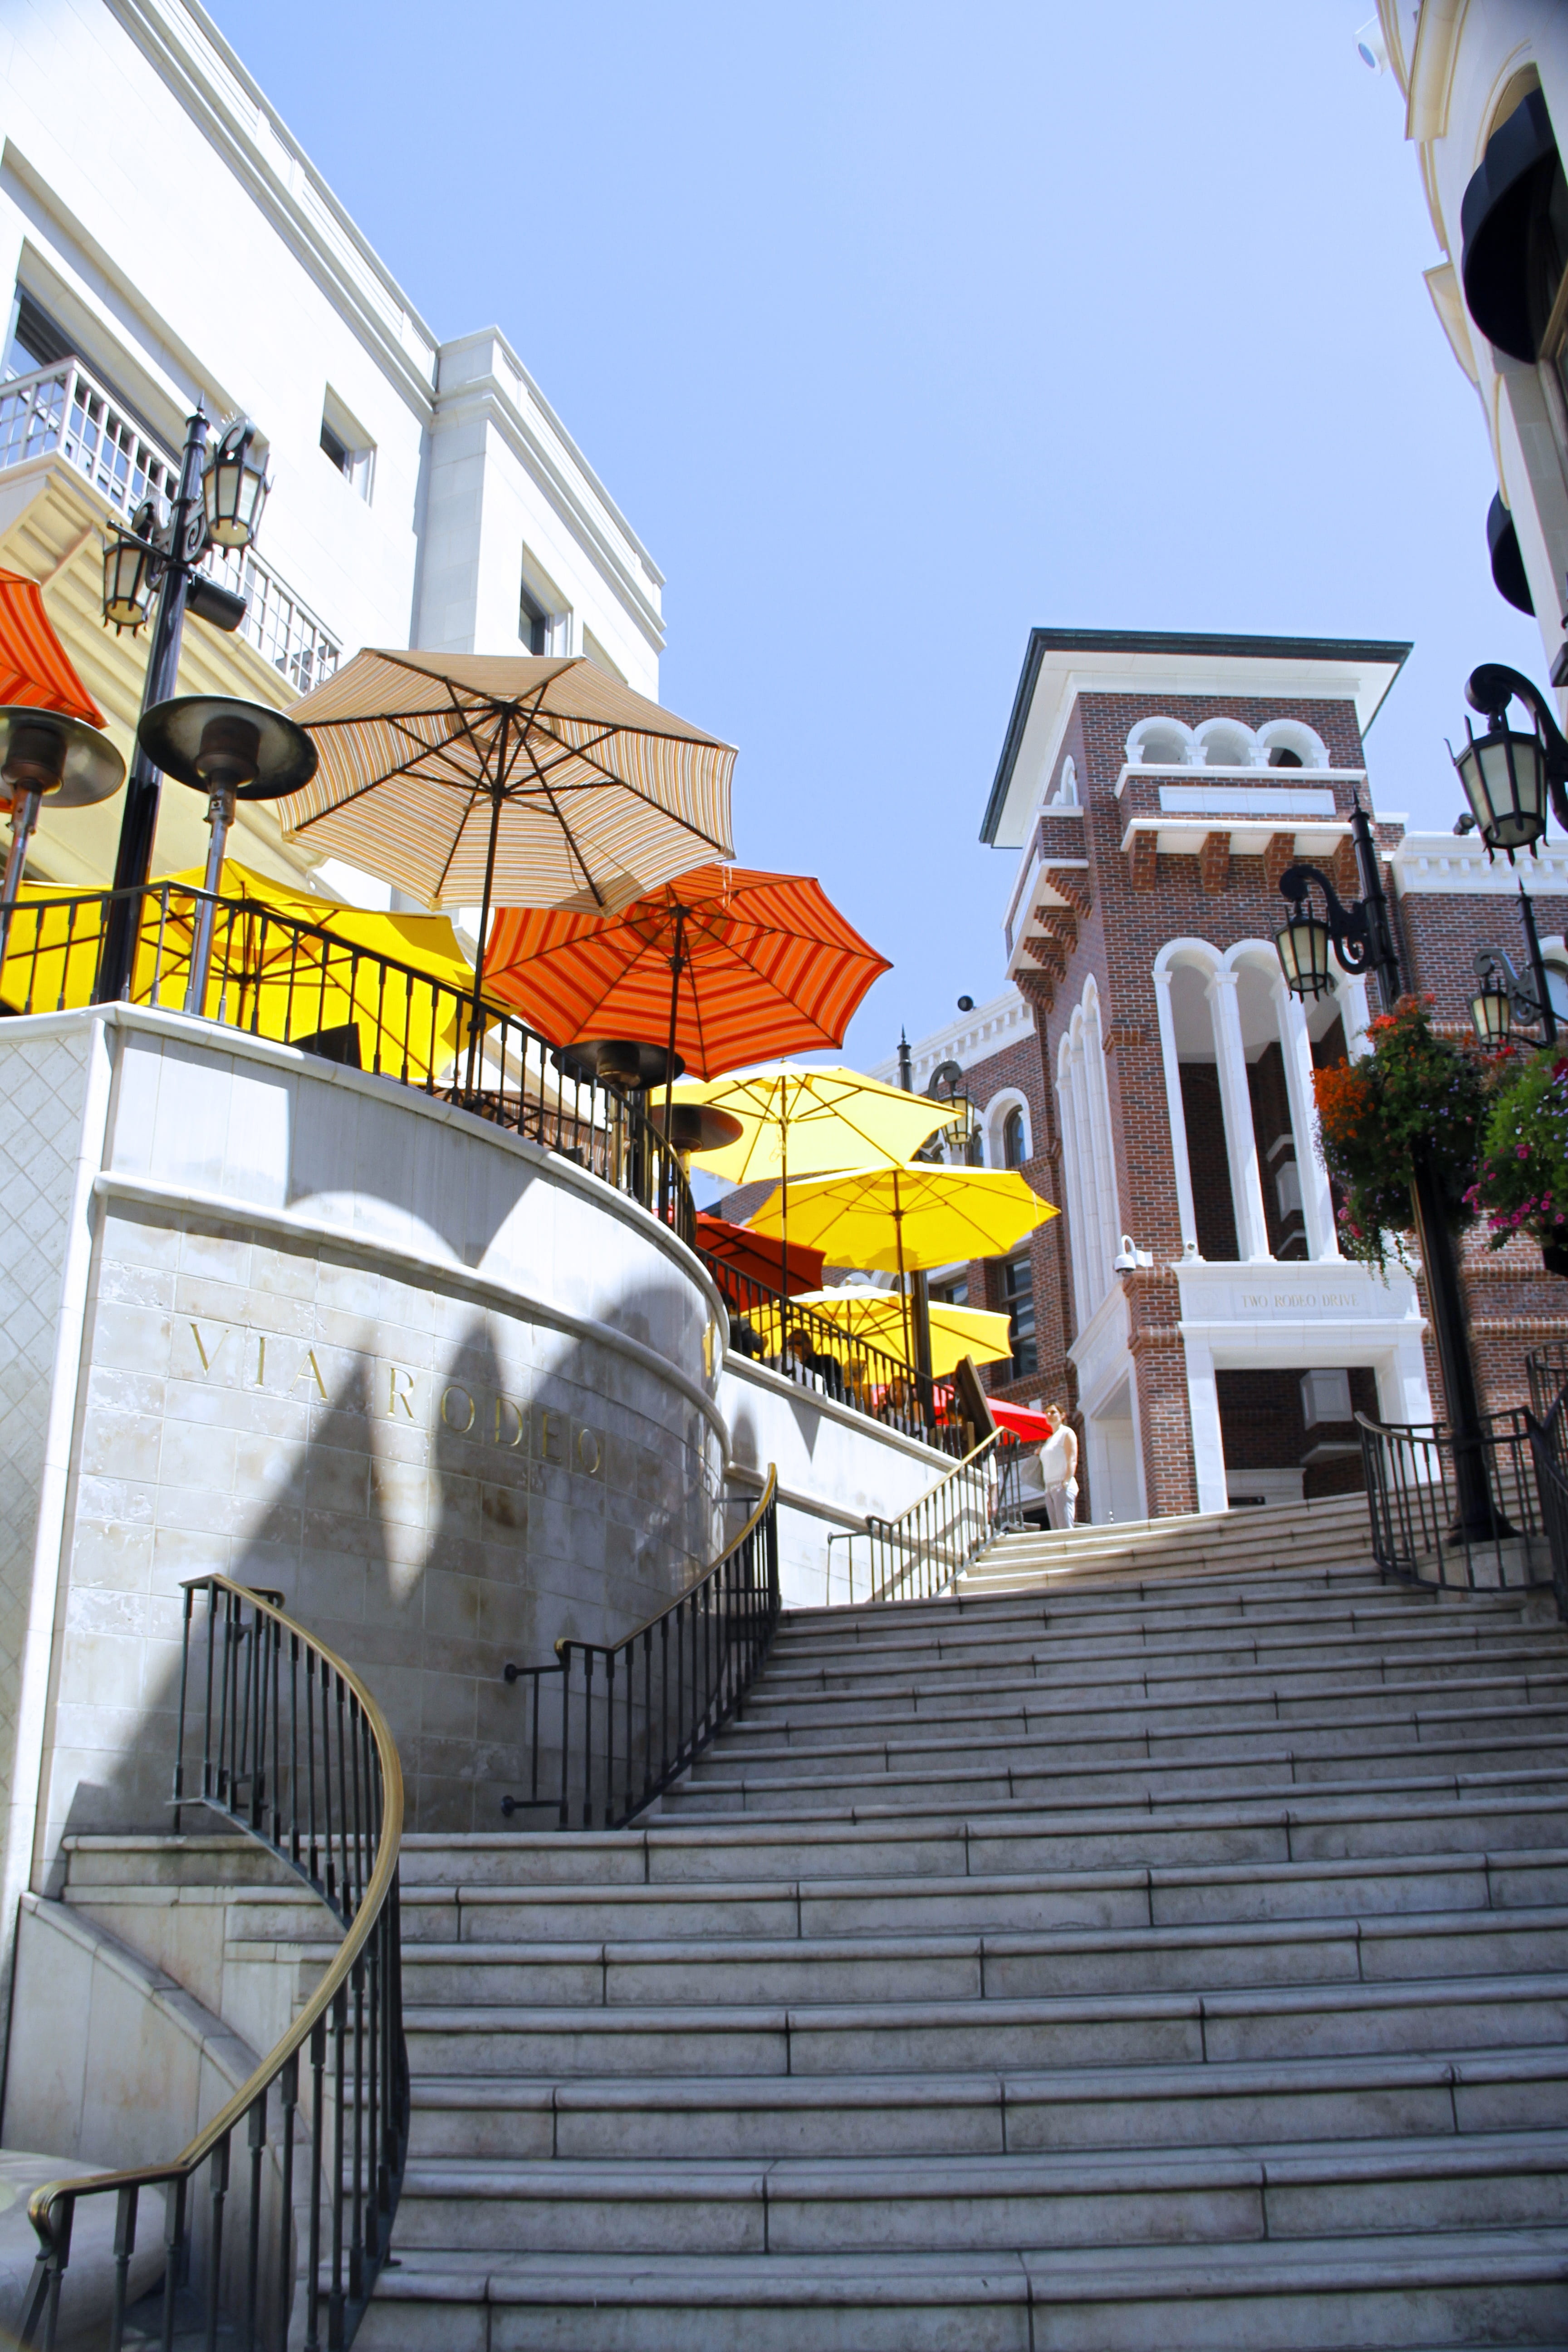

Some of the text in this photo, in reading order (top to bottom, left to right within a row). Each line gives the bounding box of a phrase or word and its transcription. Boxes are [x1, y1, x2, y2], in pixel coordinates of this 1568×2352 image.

[1241, 1294, 1359, 1308] TWO RODEO DRIVE
[189, 1323, 601, 1473] VIA RODEO
